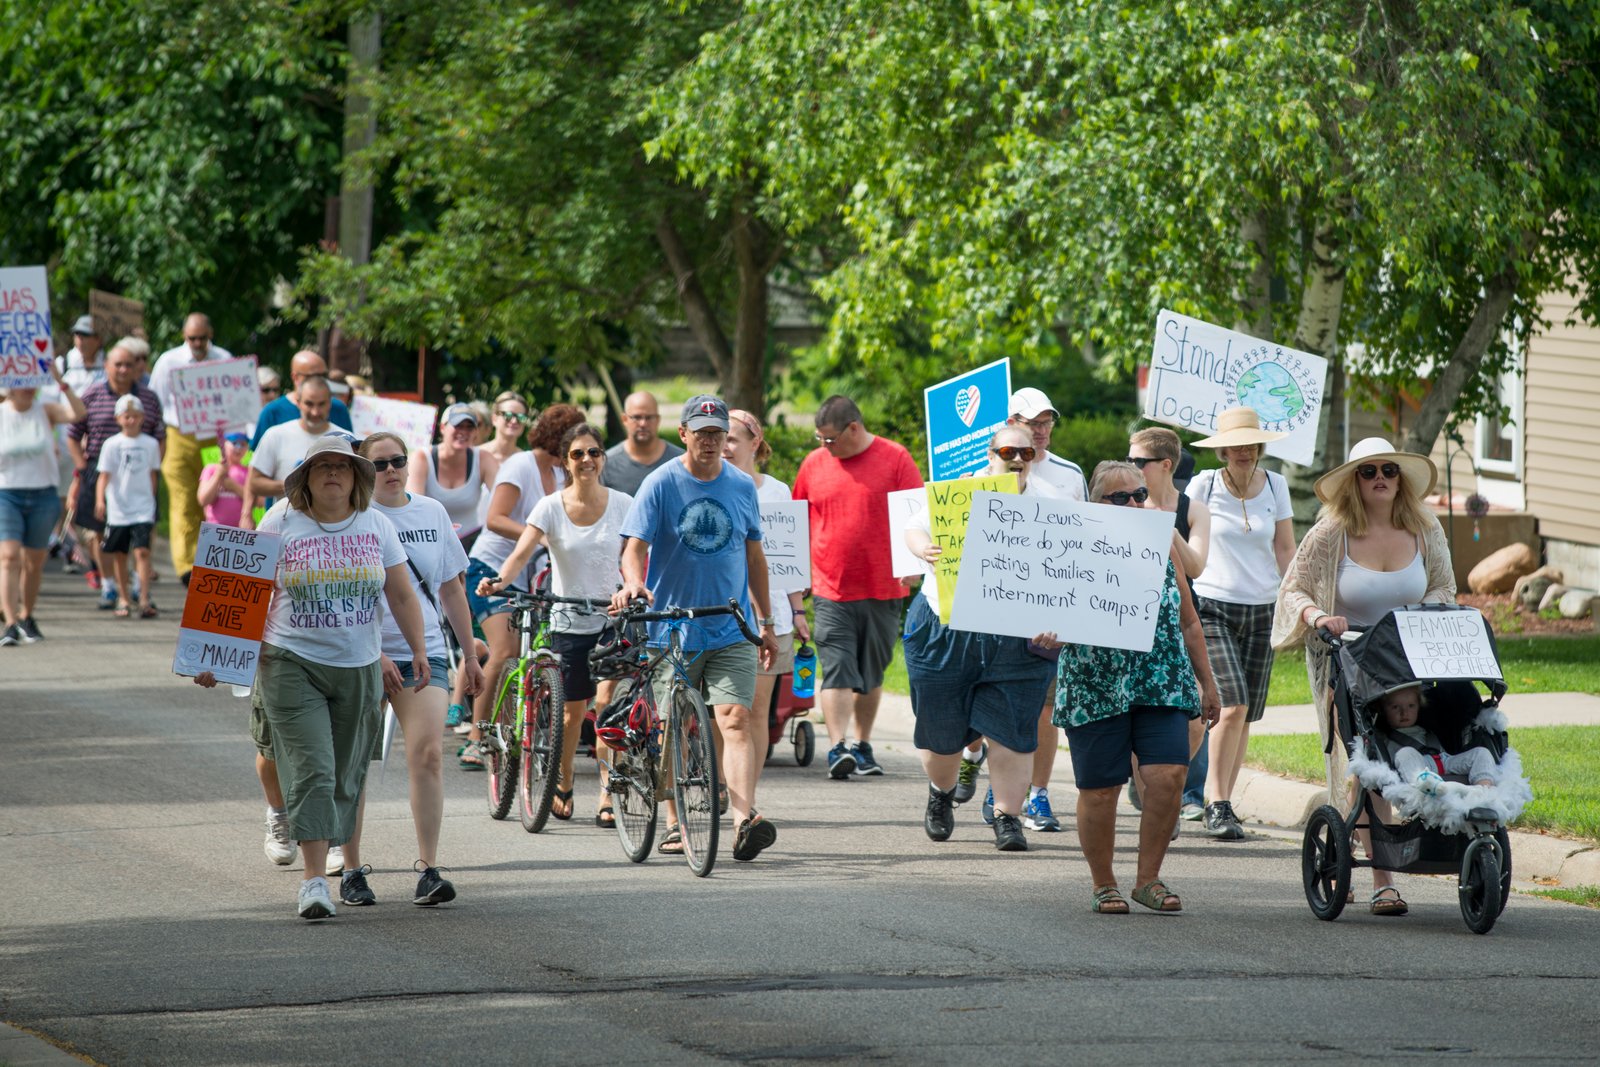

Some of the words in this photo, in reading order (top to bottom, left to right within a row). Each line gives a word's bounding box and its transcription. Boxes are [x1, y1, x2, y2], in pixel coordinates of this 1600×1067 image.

[1161, 319, 1231, 385] Stand
[1155, 366, 1226, 431] Toget
[936, 515, 954, 528] Mr
[962, 511, 970, 527] R
[988, 499, 1025, 530] Rep.
[216, 528, 258, 546] THE
[341, 533, 379, 548] HUMAN
[398, 529, 438, 544] UNITED
[936, 534, 965, 549] TAK
[982, 529, 1030, 548] Where
[1037, 530, 1053, 549] do
[1055, 540, 1083, 558] you
[1091, 535, 1132, 558] stand
[1141, 547, 1163, 566] on
[205, 545, 266, 573] KIDS
[318, 559, 346, 569] LIVES
[940, 556, 961, 565] aw
[981, 553, 1030, 581] putting
[1042, 557, 1095, 583] families
[1106, 569, 1120, 587] in
[196, 574, 270, 604] SENT
[325, 580, 360, 599] CHANGE
[291, 599, 334, 614] WATER
[342, 597, 354, 612] IS
[983, 579, 1077, 608] internment
[1089, 589, 1160, 626] camps?
[202, 602, 246, 630] ME
[290, 613, 341, 628] SCIENCE
[346, 616, 354, 627] IS
[356, 607, 376, 625] REA
[1420, 640, 1480, 657] BELONG
[1411, 657, 1500, 676] TOGETHER
